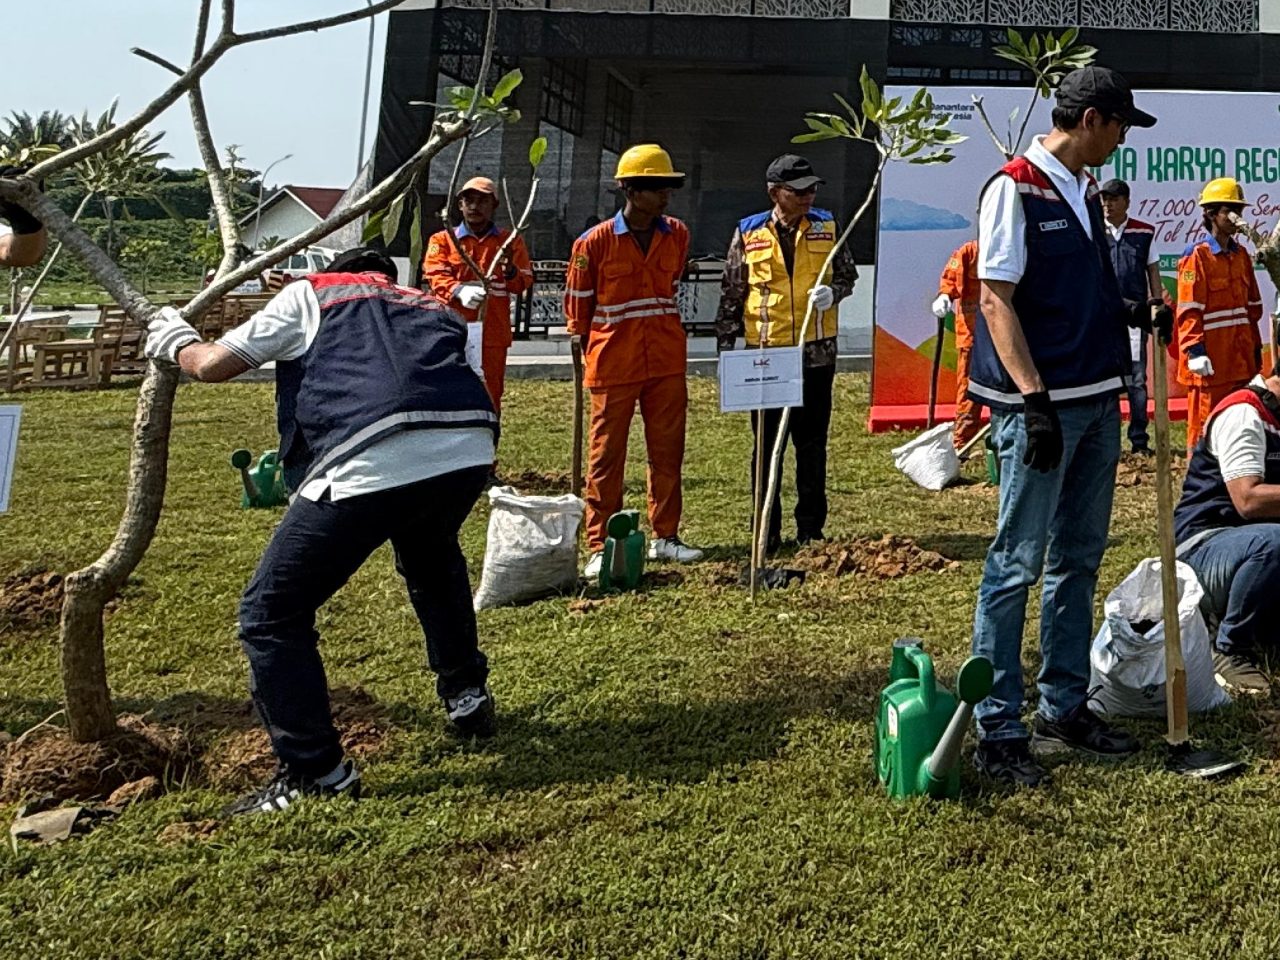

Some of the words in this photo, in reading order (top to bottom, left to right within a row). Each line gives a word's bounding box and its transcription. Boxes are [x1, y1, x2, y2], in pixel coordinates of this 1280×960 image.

[1148, 146, 1226, 182] KARYA
[1138, 199, 1196, 217] 17.000
[1154, 220, 1184, 243] Tol
